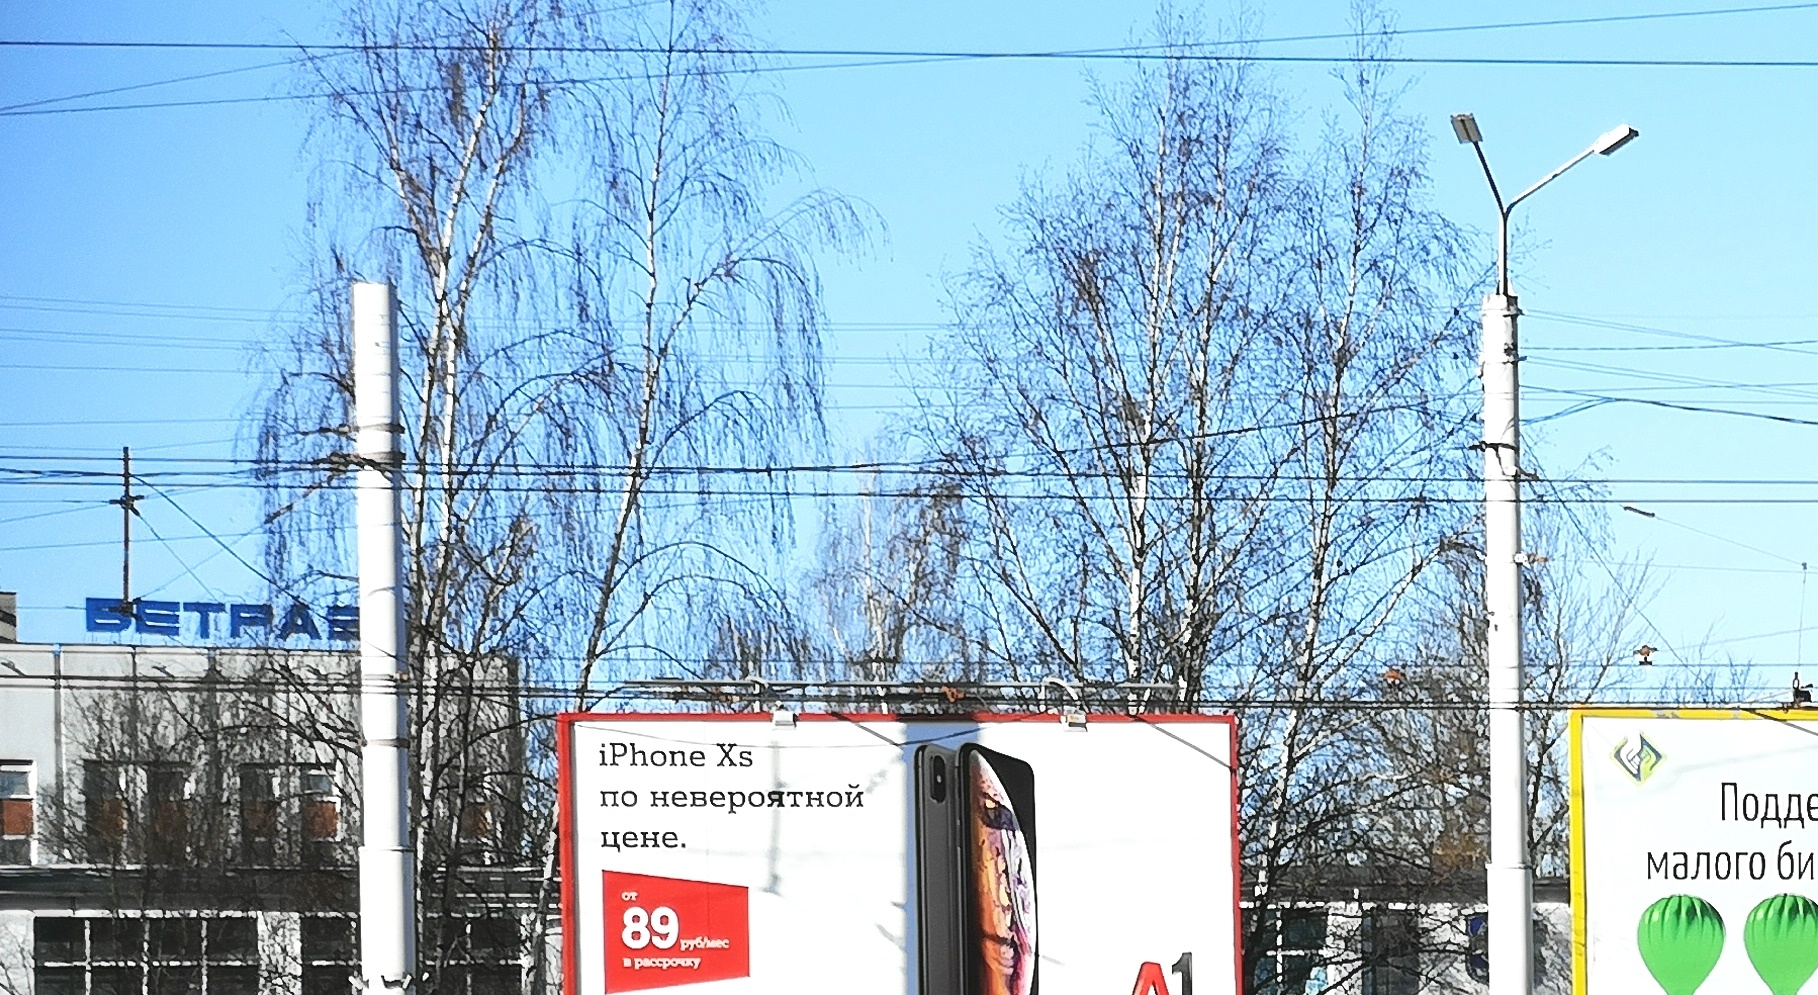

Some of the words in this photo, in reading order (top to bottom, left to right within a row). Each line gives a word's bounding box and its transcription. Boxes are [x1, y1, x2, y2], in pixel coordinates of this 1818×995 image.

[599, 743, 706, 767] iPhone
[716, 743, 753, 767] Xs
[600, 790, 638, 807] по
[650, 784, 864, 814] невероятной
[601, 831, 686, 852] цене.
[1647, 851, 1766, 880] малого
[621, 891, 638, 901] от
[621, 906, 680, 949] 89
[680, 936, 730, 951] руб/мес
[623, 958, 632, 967] в
[634, 957, 701, 970] рассрочку
